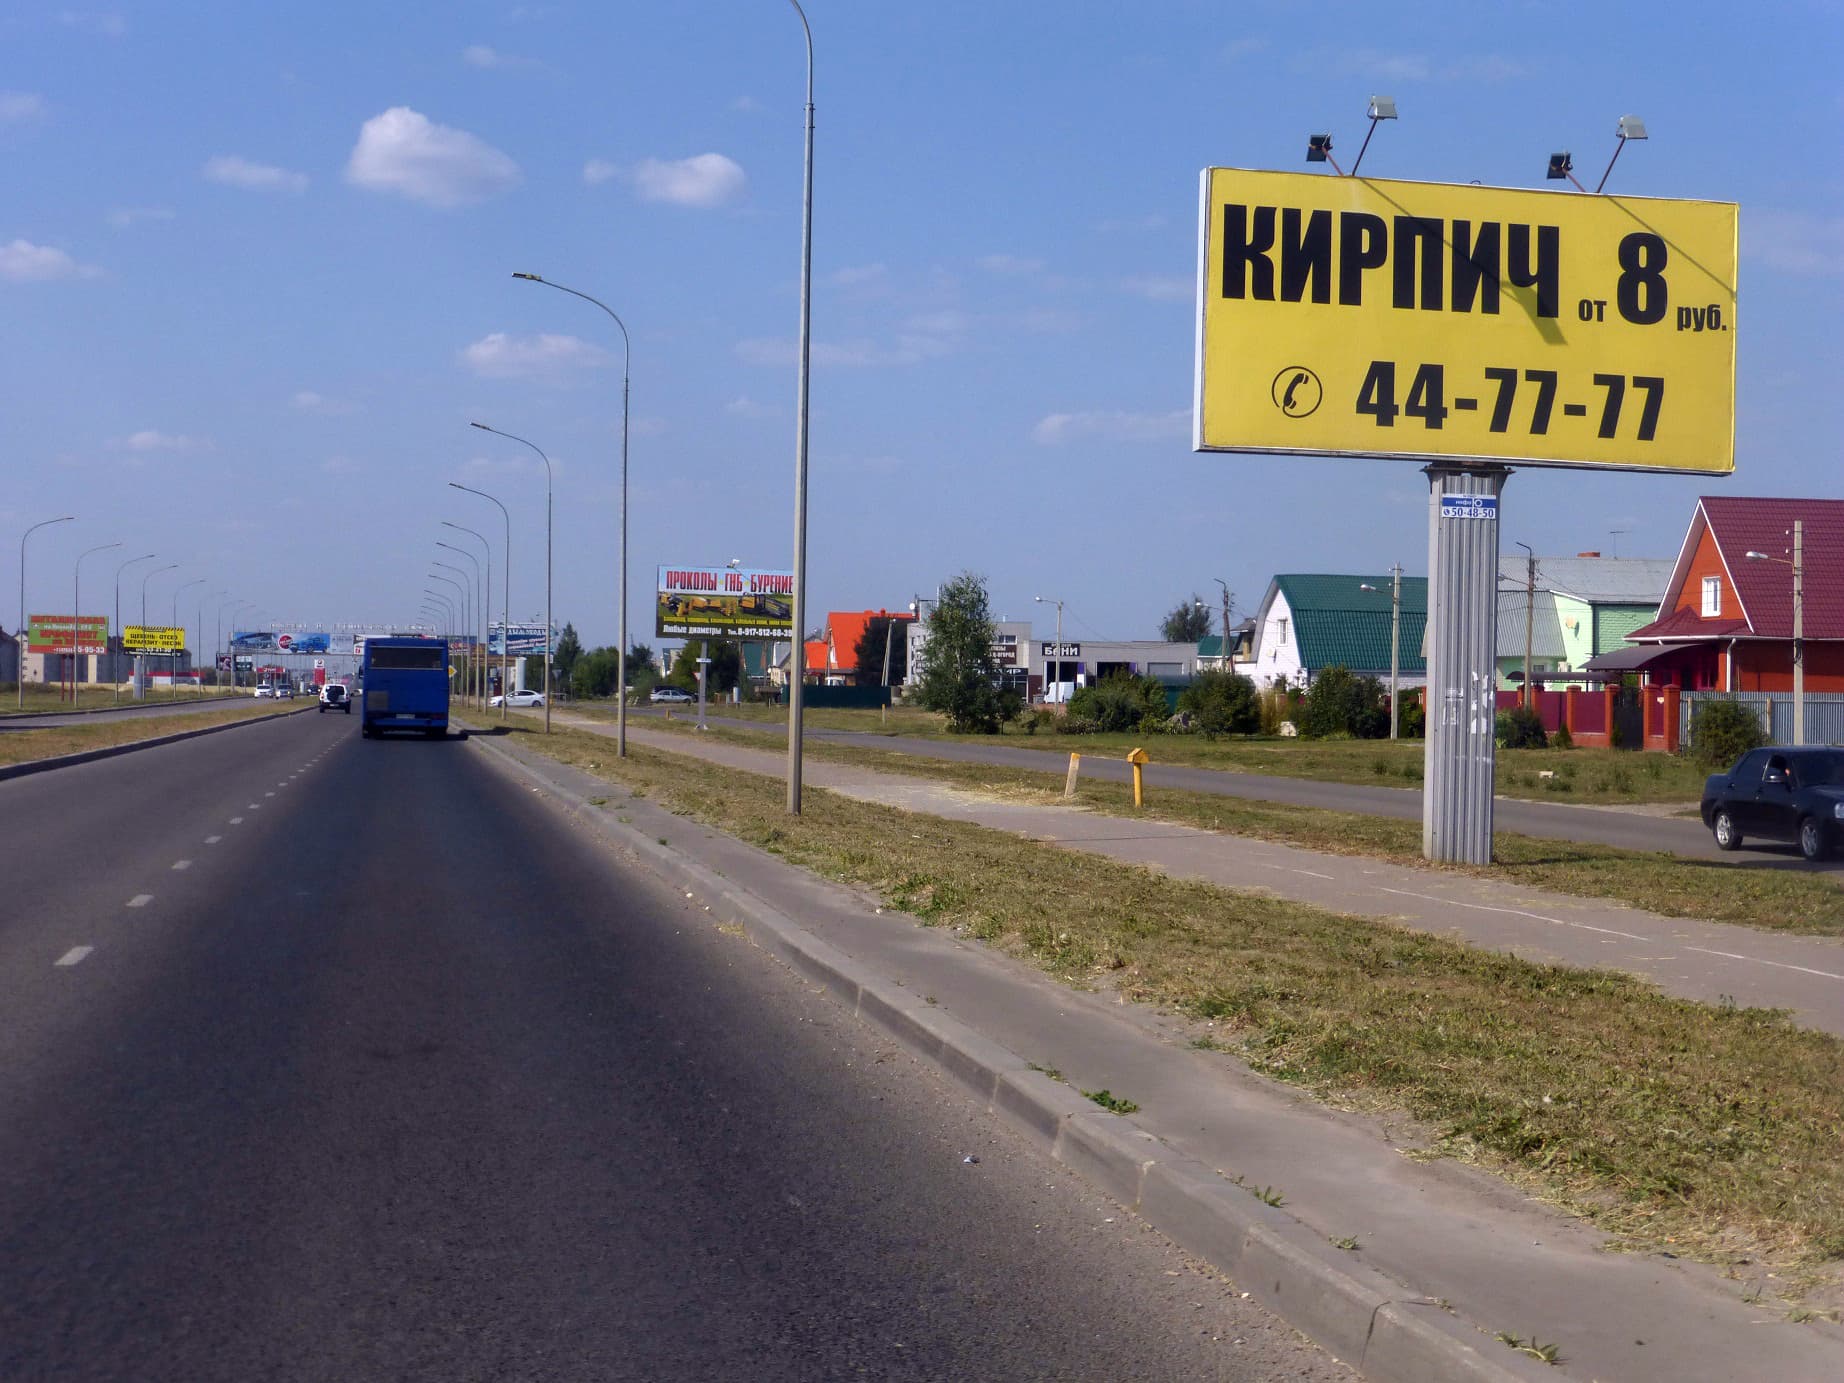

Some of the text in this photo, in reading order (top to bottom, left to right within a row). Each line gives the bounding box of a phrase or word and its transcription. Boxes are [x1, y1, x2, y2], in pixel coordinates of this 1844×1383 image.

[1222, 203, 1728, 332] КИРПИЧ от 8 руб.
[1355, 360, 1665, 441] 44-77-77
[1451, 508, 1493, 517] 50-48-50
[666, 570, 718, 591] ПРОКОЛЫ
[724, 573, 743, 592] ГНБ
